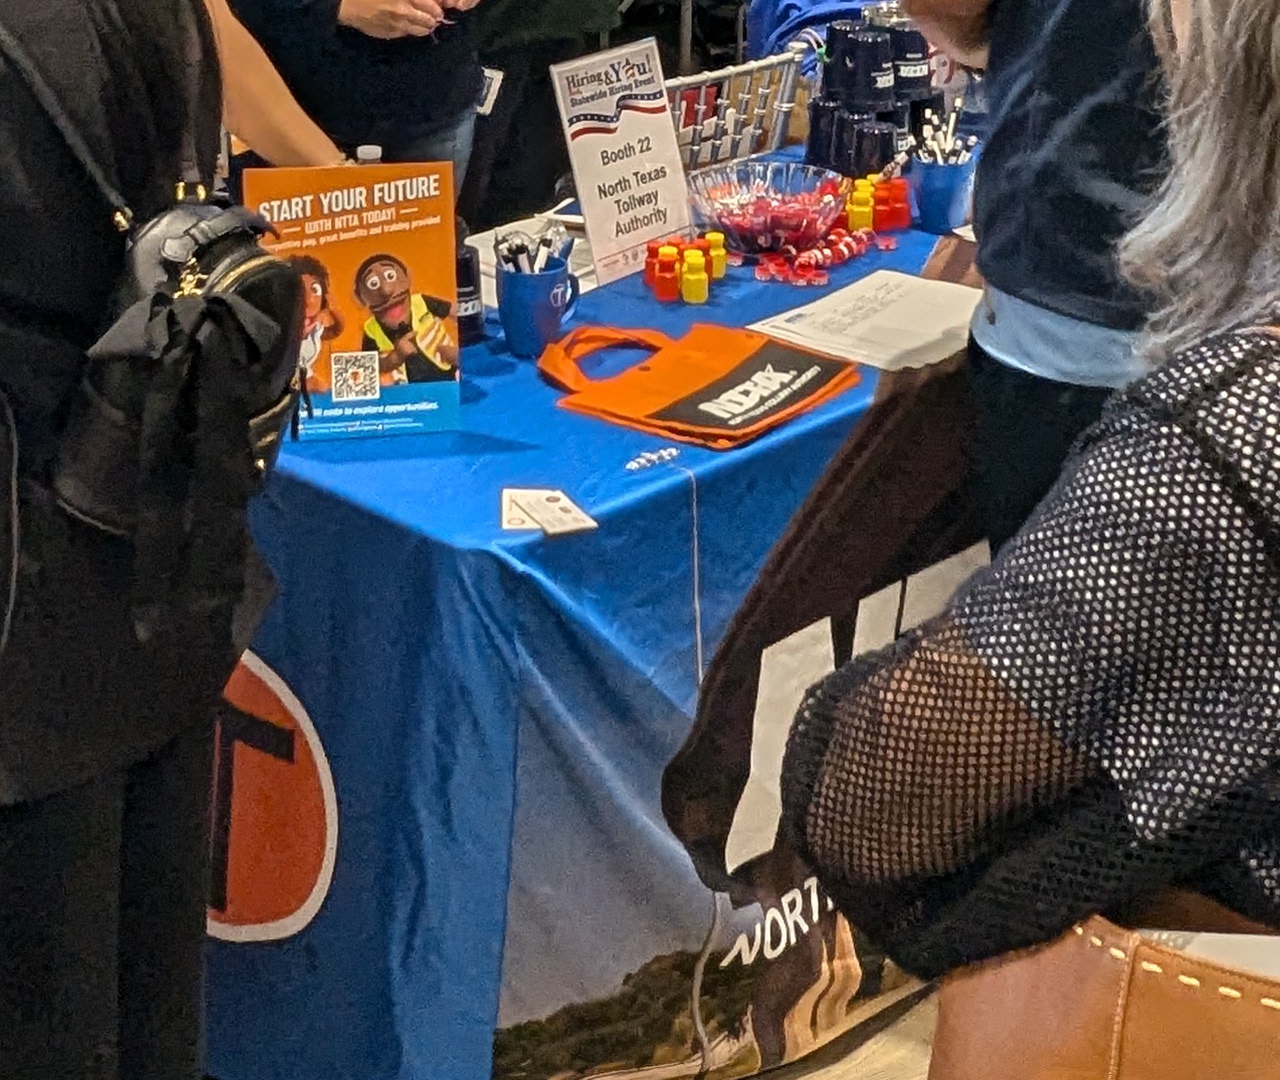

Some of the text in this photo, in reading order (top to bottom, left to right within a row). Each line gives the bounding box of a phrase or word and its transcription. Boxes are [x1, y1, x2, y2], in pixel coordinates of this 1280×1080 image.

[565, 70, 604, 91] Hiring
[570, 90, 608, 108] Statewide
[633, 75, 656, 91] Event
[600, 136, 652, 166] Booth 22
[597, 165, 667, 200] North Texas
[259, 174, 440, 223] START YOUR FUTURE
[614, 190, 659, 216] Tollway
[305, 218, 332, 235] WITH
[362, 207, 396, 225] TODAY!
[615, 206, 668, 238] Authority
